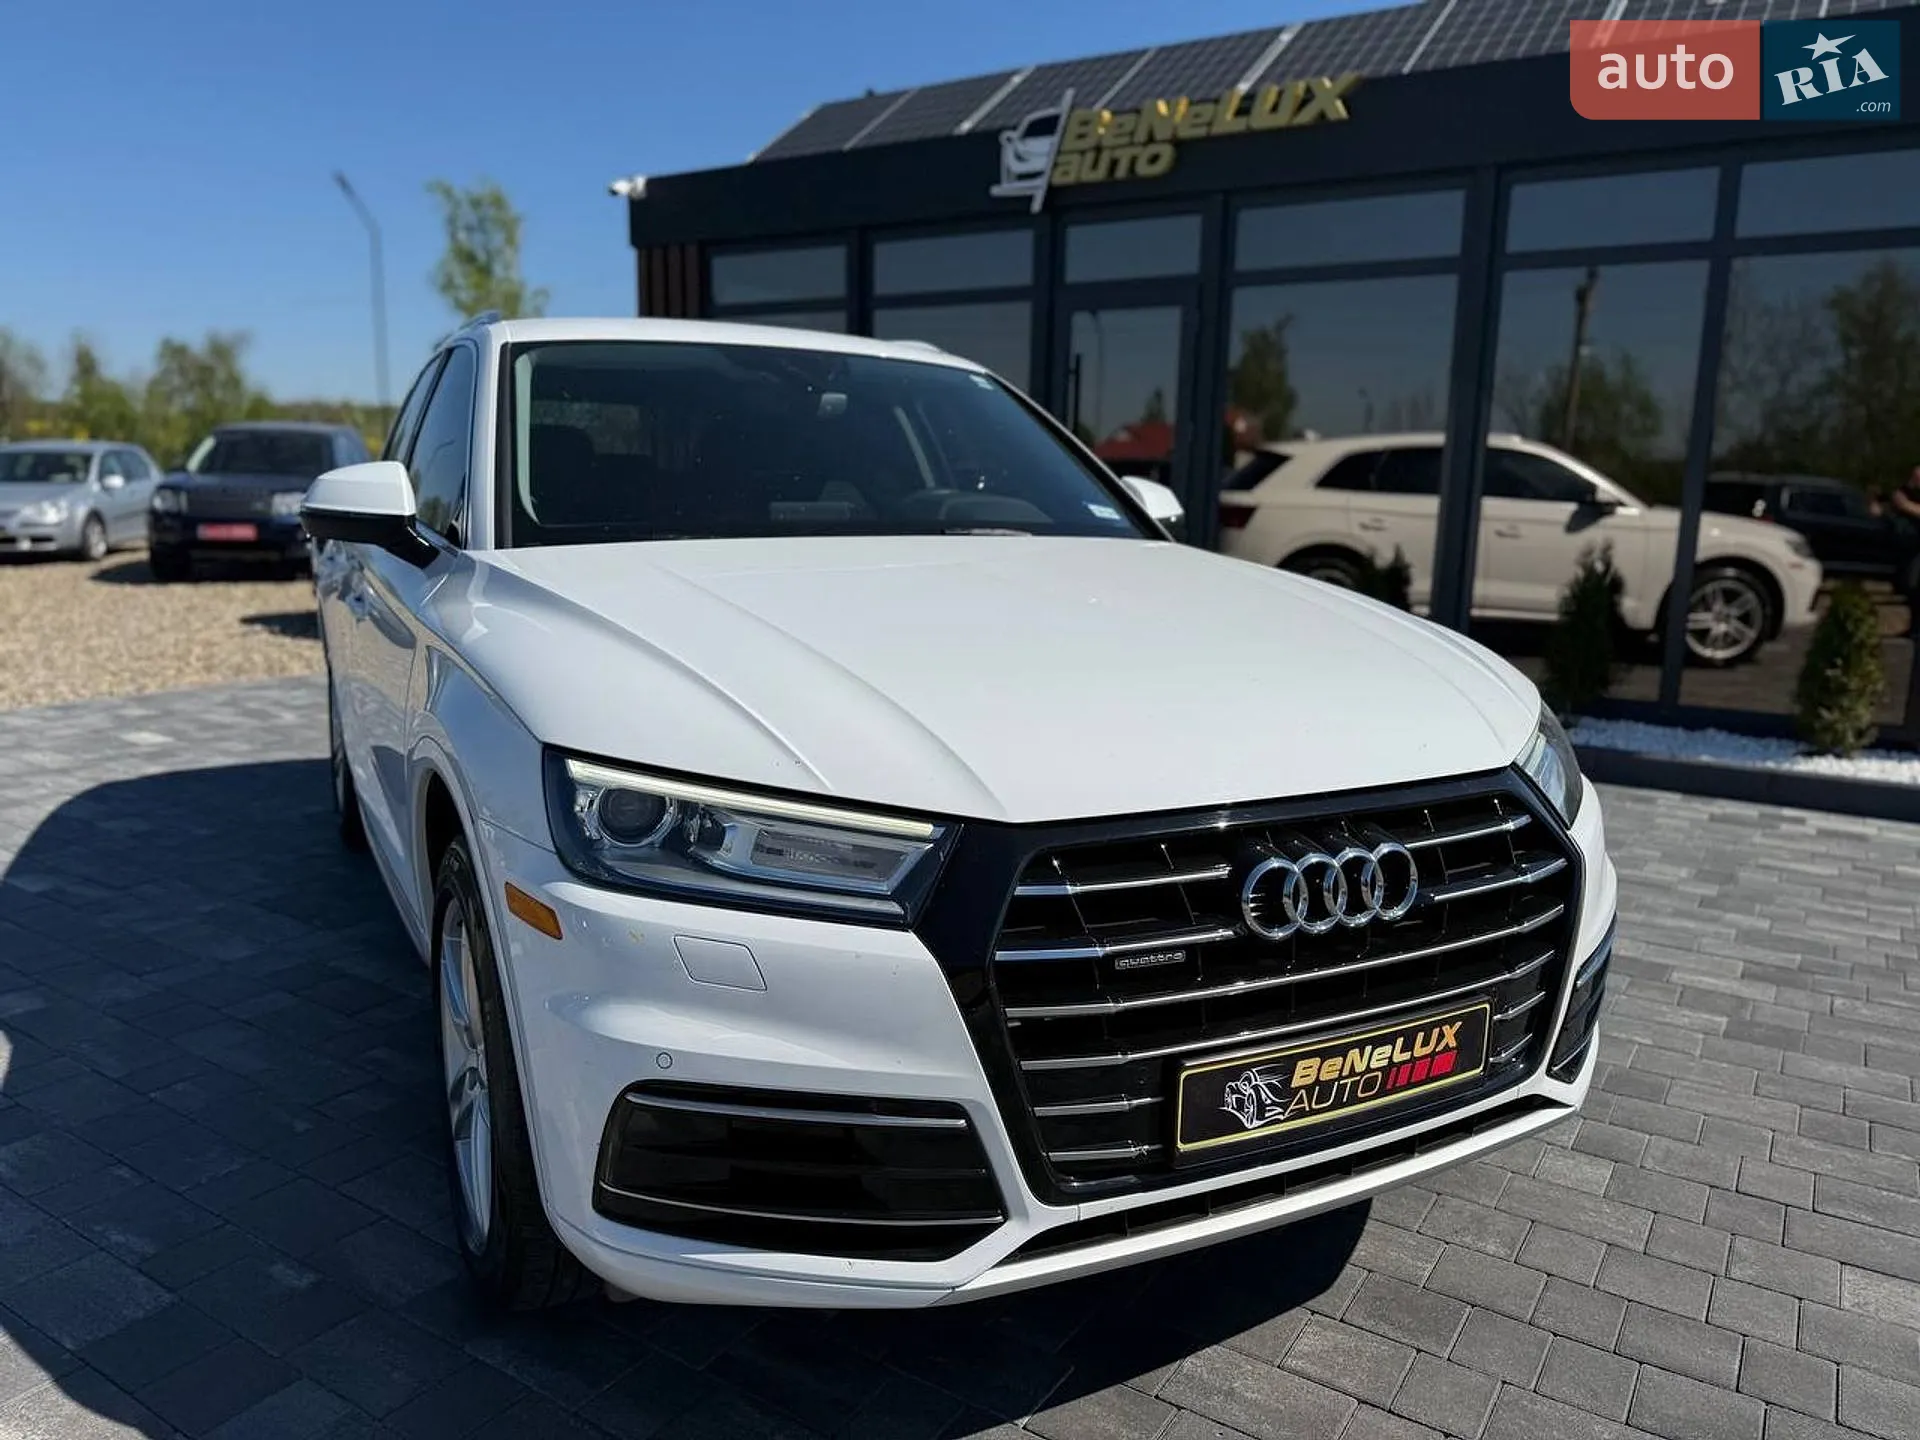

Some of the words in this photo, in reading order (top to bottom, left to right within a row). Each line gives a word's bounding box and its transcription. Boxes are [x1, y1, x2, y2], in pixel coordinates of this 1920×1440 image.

[1060, 72, 1361, 150] BeNeLUX
[1290, 1021, 1462, 1088] BeNeLUX
[1284, 1072, 1383, 1117] AUTO
